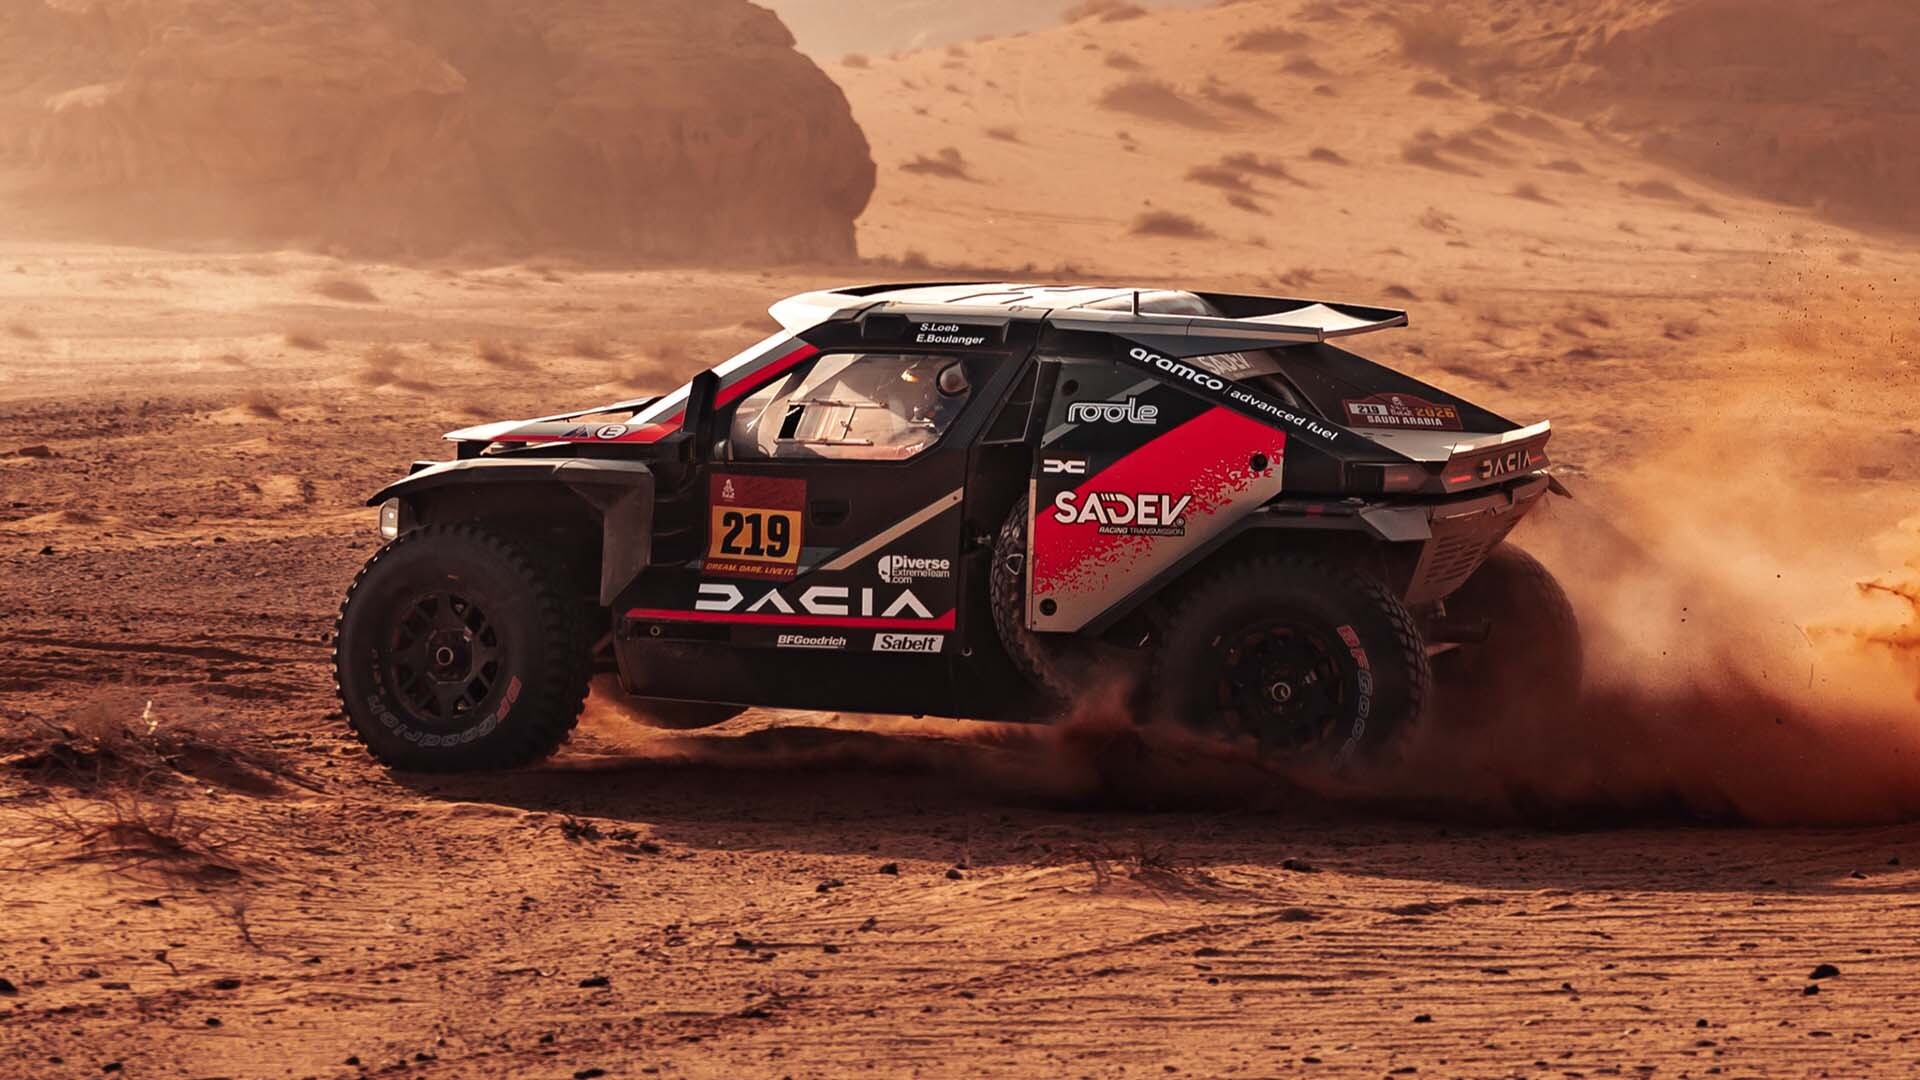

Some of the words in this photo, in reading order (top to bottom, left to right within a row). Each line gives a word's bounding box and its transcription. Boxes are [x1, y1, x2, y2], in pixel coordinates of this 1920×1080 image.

[920, 323, 959, 332] S.Loeb
[916, 333, 984, 345] E.Boulanger
[1129, 347, 1224, 391] aramco
[1230, 389, 1305, 426] advanced
[1307, 421, 1338, 441] fuel
[1357, 404, 1381, 414] 219
[1416, 407, 1455, 418] 2026
[1367, 415, 1400, 424] SAUDI
[1403, 416, 1443, 426] ARABIA
[1480, 450, 1532, 479] DACIA
[720, 511, 790, 558] 219
[1099, 526, 1128, 535] RACING
[1129, 527, 1184, 536] TRANSMISSION
[706, 563, 736, 572] DREAM.
[739, 565, 763, 574] DARE.
[764, 567, 783, 575] LIVE
[892, 555, 950, 570] Diverse
[892, 568, 950, 578] ExtremeTeam
[892, 576, 912, 584] .com
[694, 583, 934, 618] DACIA
[777, 634, 847, 647] BFGoodrich
[880, 635, 937, 651] Sabelt
